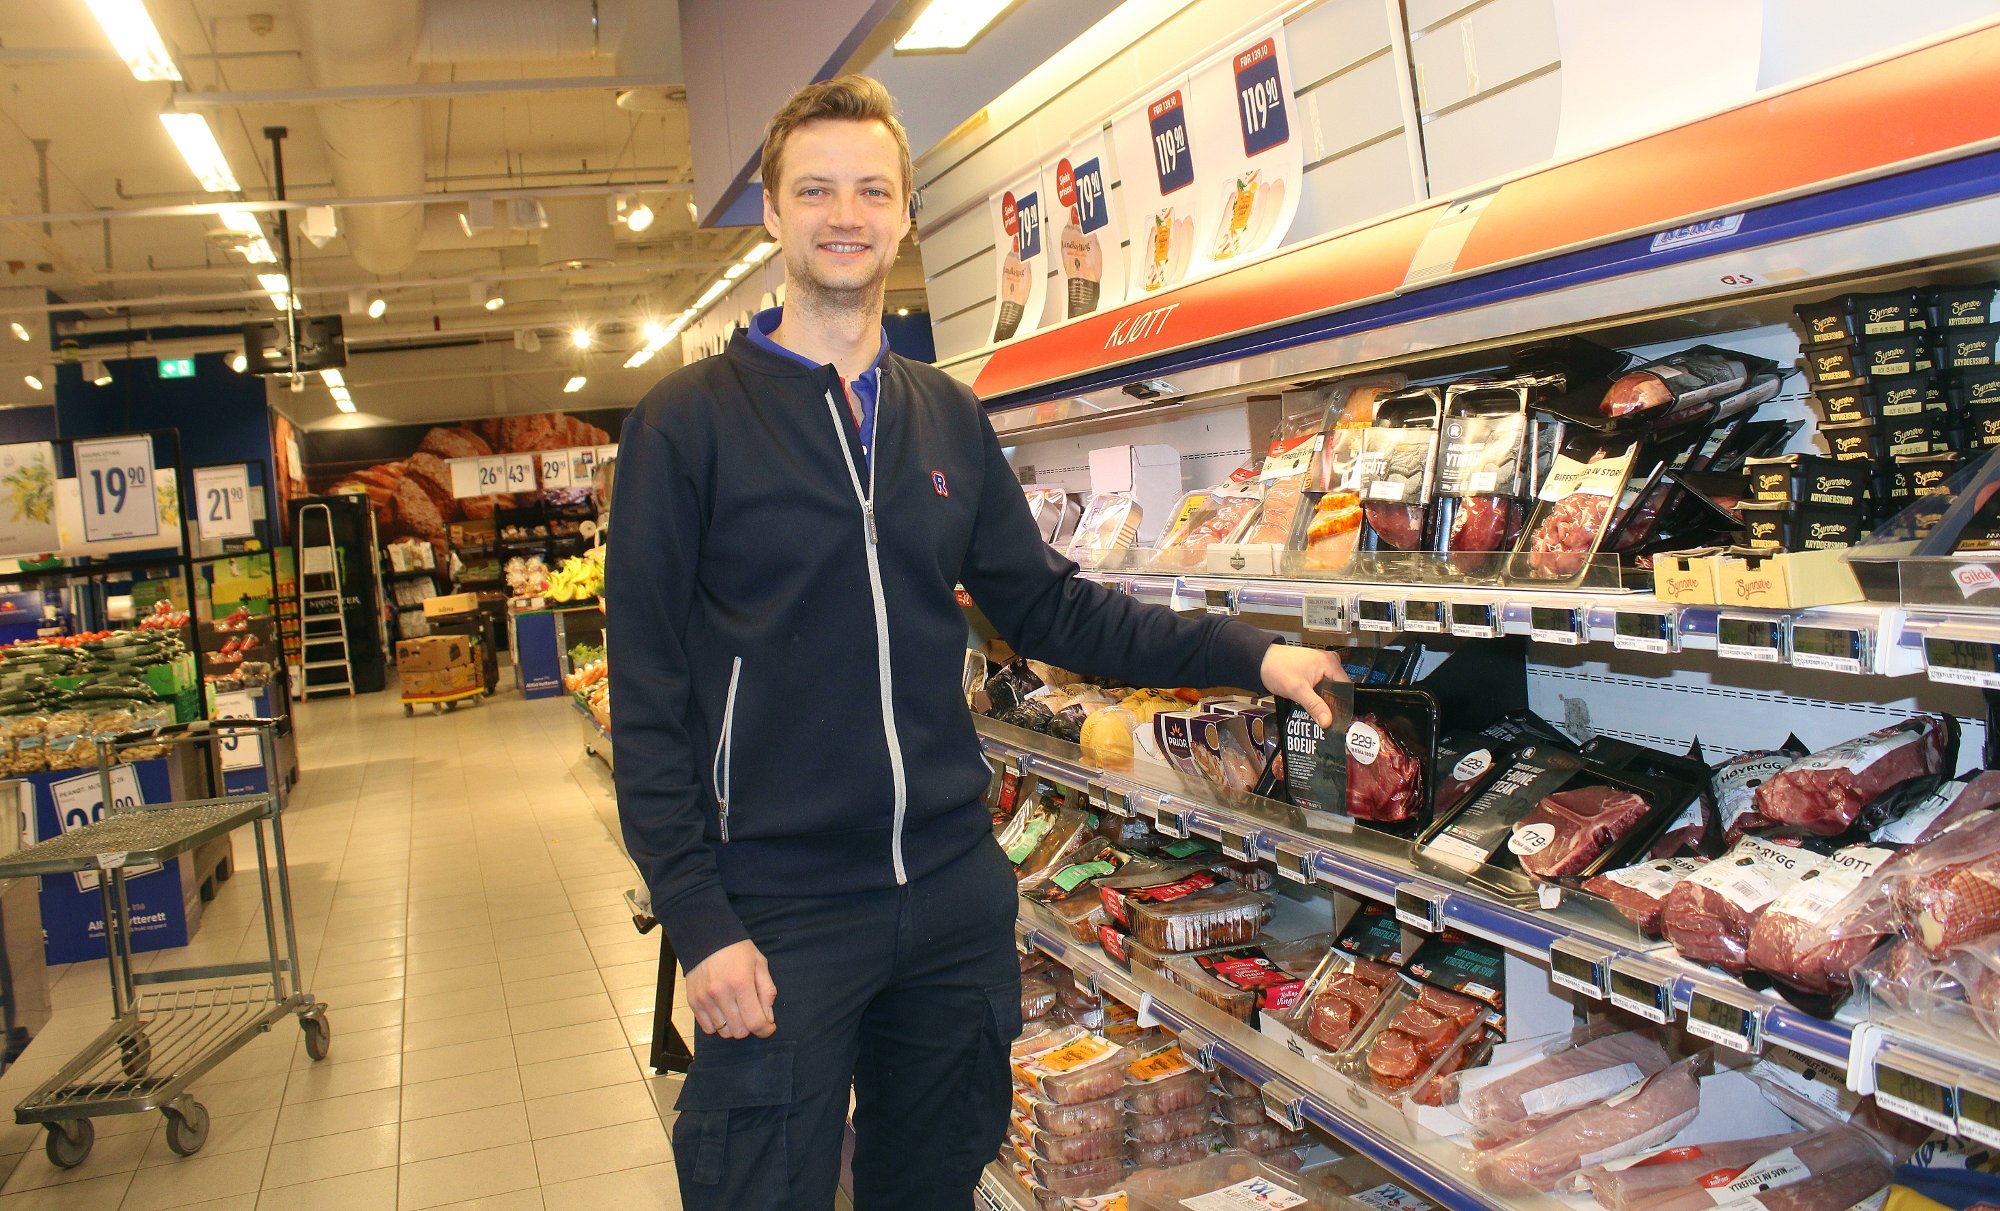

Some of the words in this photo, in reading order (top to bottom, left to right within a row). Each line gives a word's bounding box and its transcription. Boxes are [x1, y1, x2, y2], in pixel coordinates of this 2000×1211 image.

[1242, 82, 1268, 135] 119
[1265, 76, 1278, 104] 90
[1156, 129, 1177, 176] 119
[1174, 124, 1185, 147] 90
[1076, 174, 1094, 222] 79
[1090, 170, 1101, 192] 90
[1018, 207, 1032, 250] 79
[1030, 204, 1038, 224] 90
[1868, 306, 1900, 322] Synnøve
[1951, 300, 1983, 316] Synnøve
[1103, 303, 1180, 349] KJØTT
[1812, 316, 1838, 332] Synnøve
[1948, 315, 1985, 326] KRYDDERSMØR
[1813, 331, 1844, 343] KRYDDERSMØR
[1875, 347, 1905, 364] Synnøve
[1957, 340, 1987, 357] Synnøve
[1817, 354, 1845, 372] Synnøve
[1953, 356, 1990, 367] KRYDDERSMØR
[1818, 370, 1851, 382] KRYDDERSMØR
[1828, 396, 1855, 412] Synnøve
[1887, 387, 1918, 404] Synnøve
[1829, 411, 1861, 422] KRYDDERSMØR
[1835, 435, 1862, 453] Synnøve
[1893, 427, 1925, 444] Synnøve
[479, 466, 497, 486] 26
[508, 464, 524, 483] 43
[543, 461, 560, 480] 29
[1913, 469, 1944, 486] Synnøve
[1758, 473, 1784, 490] Synnøve
[1816, 476, 1852, 493] Synnøve
[91, 467, 127, 515] 19
[127, 466, 145, 485] 90
[1758, 491, 1788, 501] KRYDDERSMØR
[207, 487, 232, 522] 21
[230, 486, 244, 500] 90
[1810, 493, 1853, 506] KRYDDERSMØR
[1751, 521, 1777, 538] Synnøve
[1810, 522, 1848, 539] Synnøve
[1805, 539, 1848, 551] KRYDDERSMØR
[1959, 568, 1992, 585] Gilde
[1666, 577, 1699, 598] Synnøve
[1735, 578, 1772, 600] Synnøve
[1287, 717, 1311, 738] CÔTE
[1313, 724, 1326, 740] DE
[1168, 736, 1188, 749] PRIOR
[1287, 735, 1317, 755] BOEUF
[1500, 769, 1538, 787] T-BONE
[1720, 761, 1782, 784] HØYRYGG
[1488, 780, 1520, 796] STEAK
[1788, 1048, 1820, 1072] YTREFILET
[1819, 1064, 1830, 1077] AV
[1829, 1070, 1847, 1085] SVIN
[1729, 1176, 1763, 1193] YTREFILET
[1763, 1173, 1772, 1181] AV
[1771, 1167, 1788, 1178] SVIN
